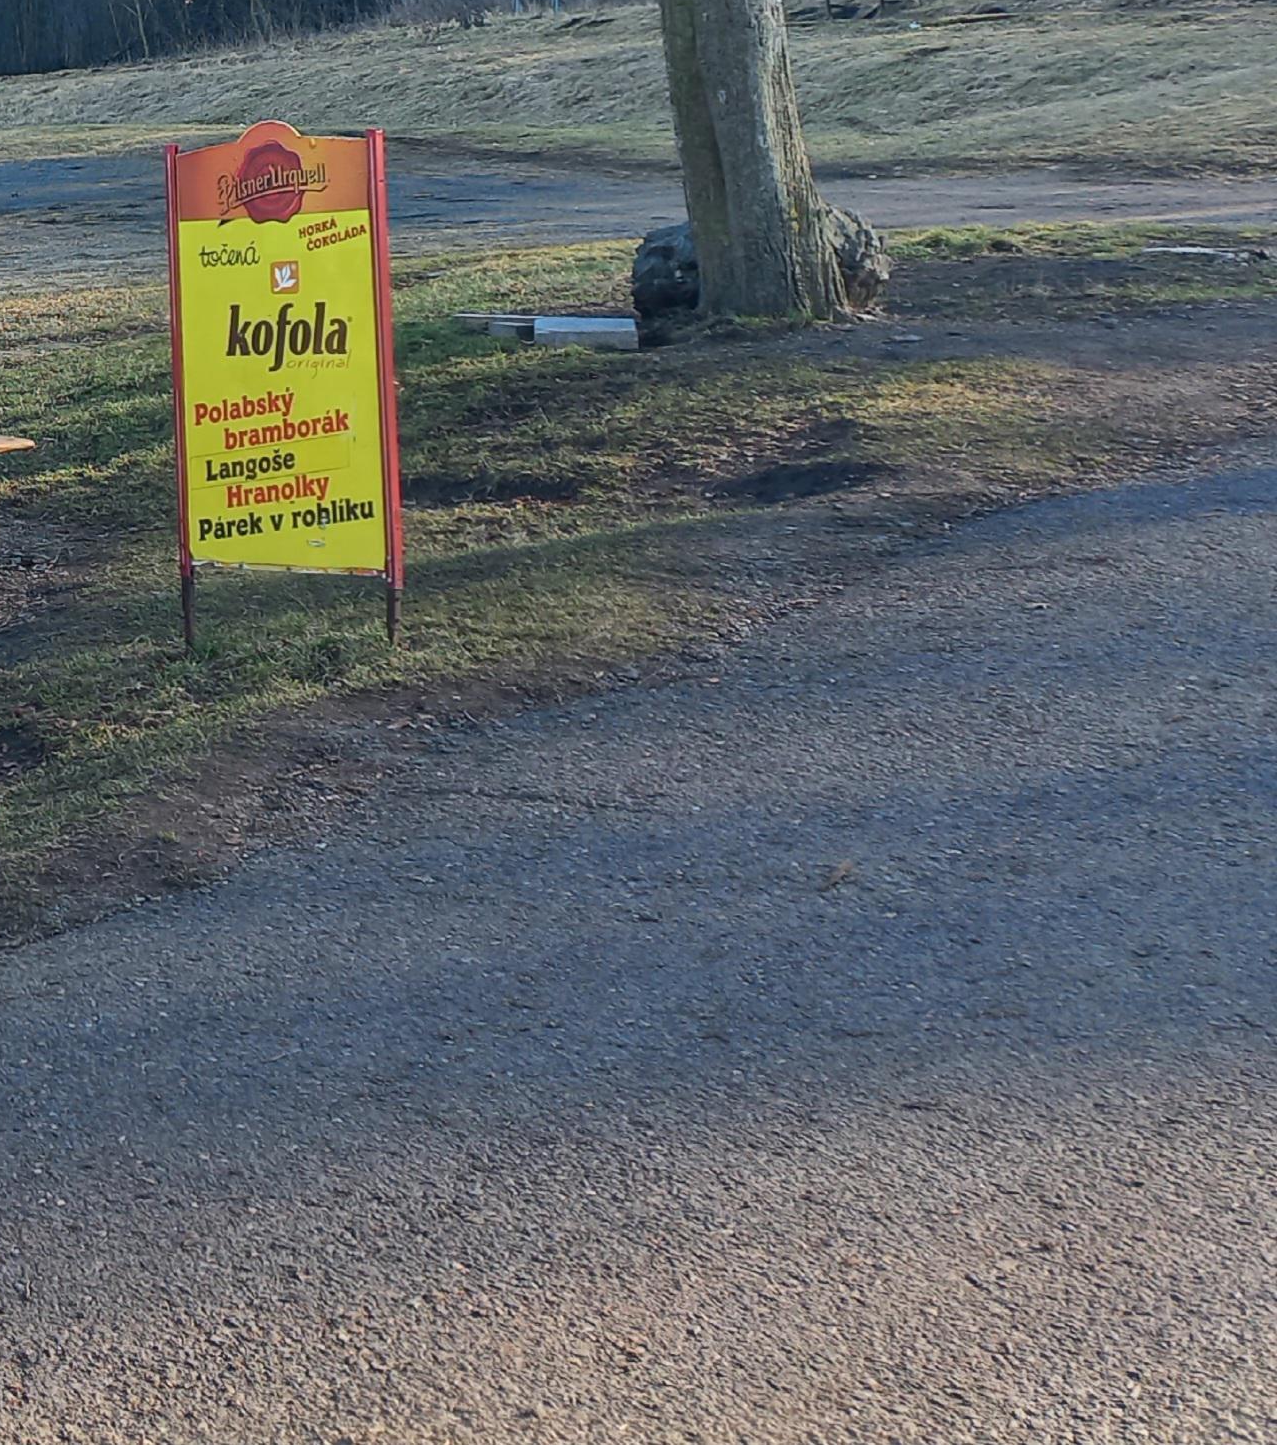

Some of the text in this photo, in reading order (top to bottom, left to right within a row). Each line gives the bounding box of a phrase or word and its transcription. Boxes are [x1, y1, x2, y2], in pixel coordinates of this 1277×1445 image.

[217, 163, 326, 215] Pilsner Urquell
[298, 217, 338, 239] HORKÁ
[306, 224, 367, 252] ČOKOLÁDA
[198, 241, 261, 268] točená
[226, 302, 349, 372] kofola
[286, 349, 352, 379] original
[194, 387, 295, 427] Polabský
[223, 408, 350, 451] bramborák
[205, 448, 296, 482] Langoše
[227, 474, 330, 509] Hranolky
[198, 498, 375, 542] Párek v rohlíku
